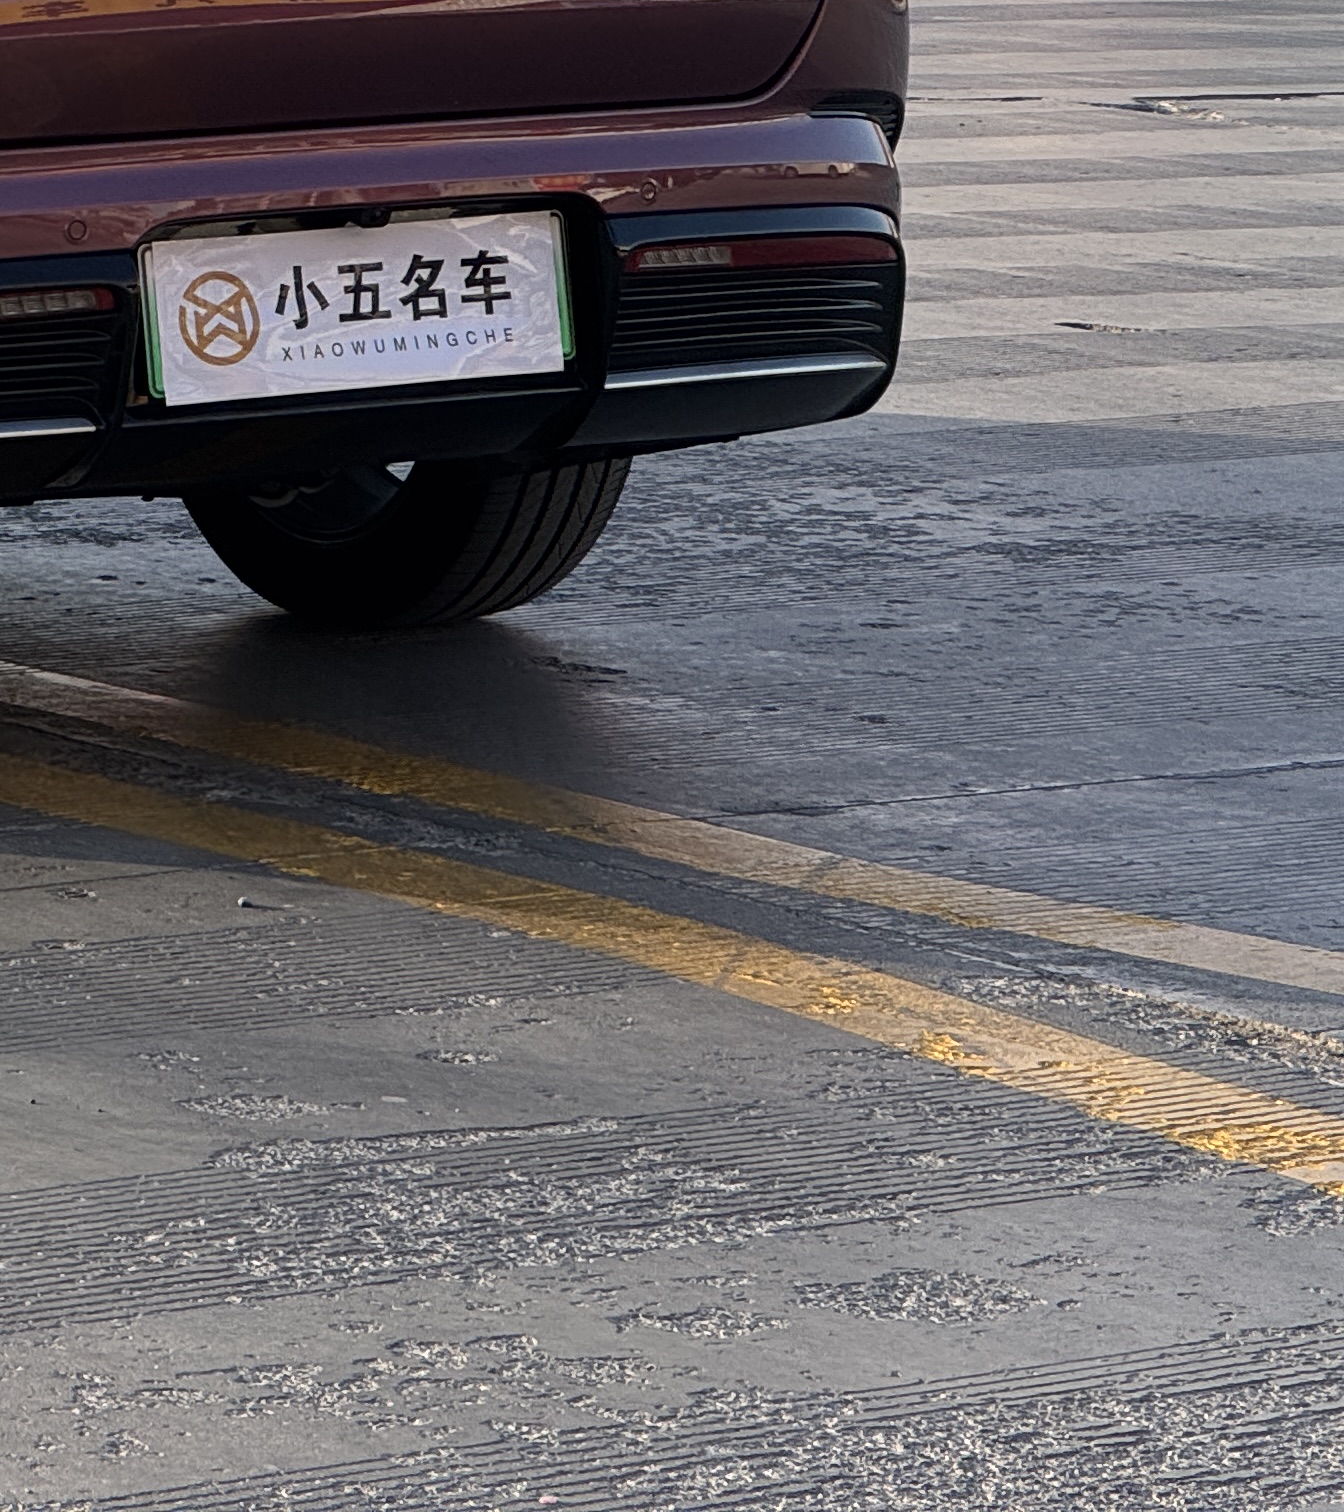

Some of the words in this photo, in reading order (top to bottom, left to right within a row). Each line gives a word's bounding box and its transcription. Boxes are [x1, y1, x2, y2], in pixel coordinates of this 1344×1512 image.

[274, 249, 513, 330] 小五名车
[281, 327, 514, 363] XIAOWUMINGCHE
